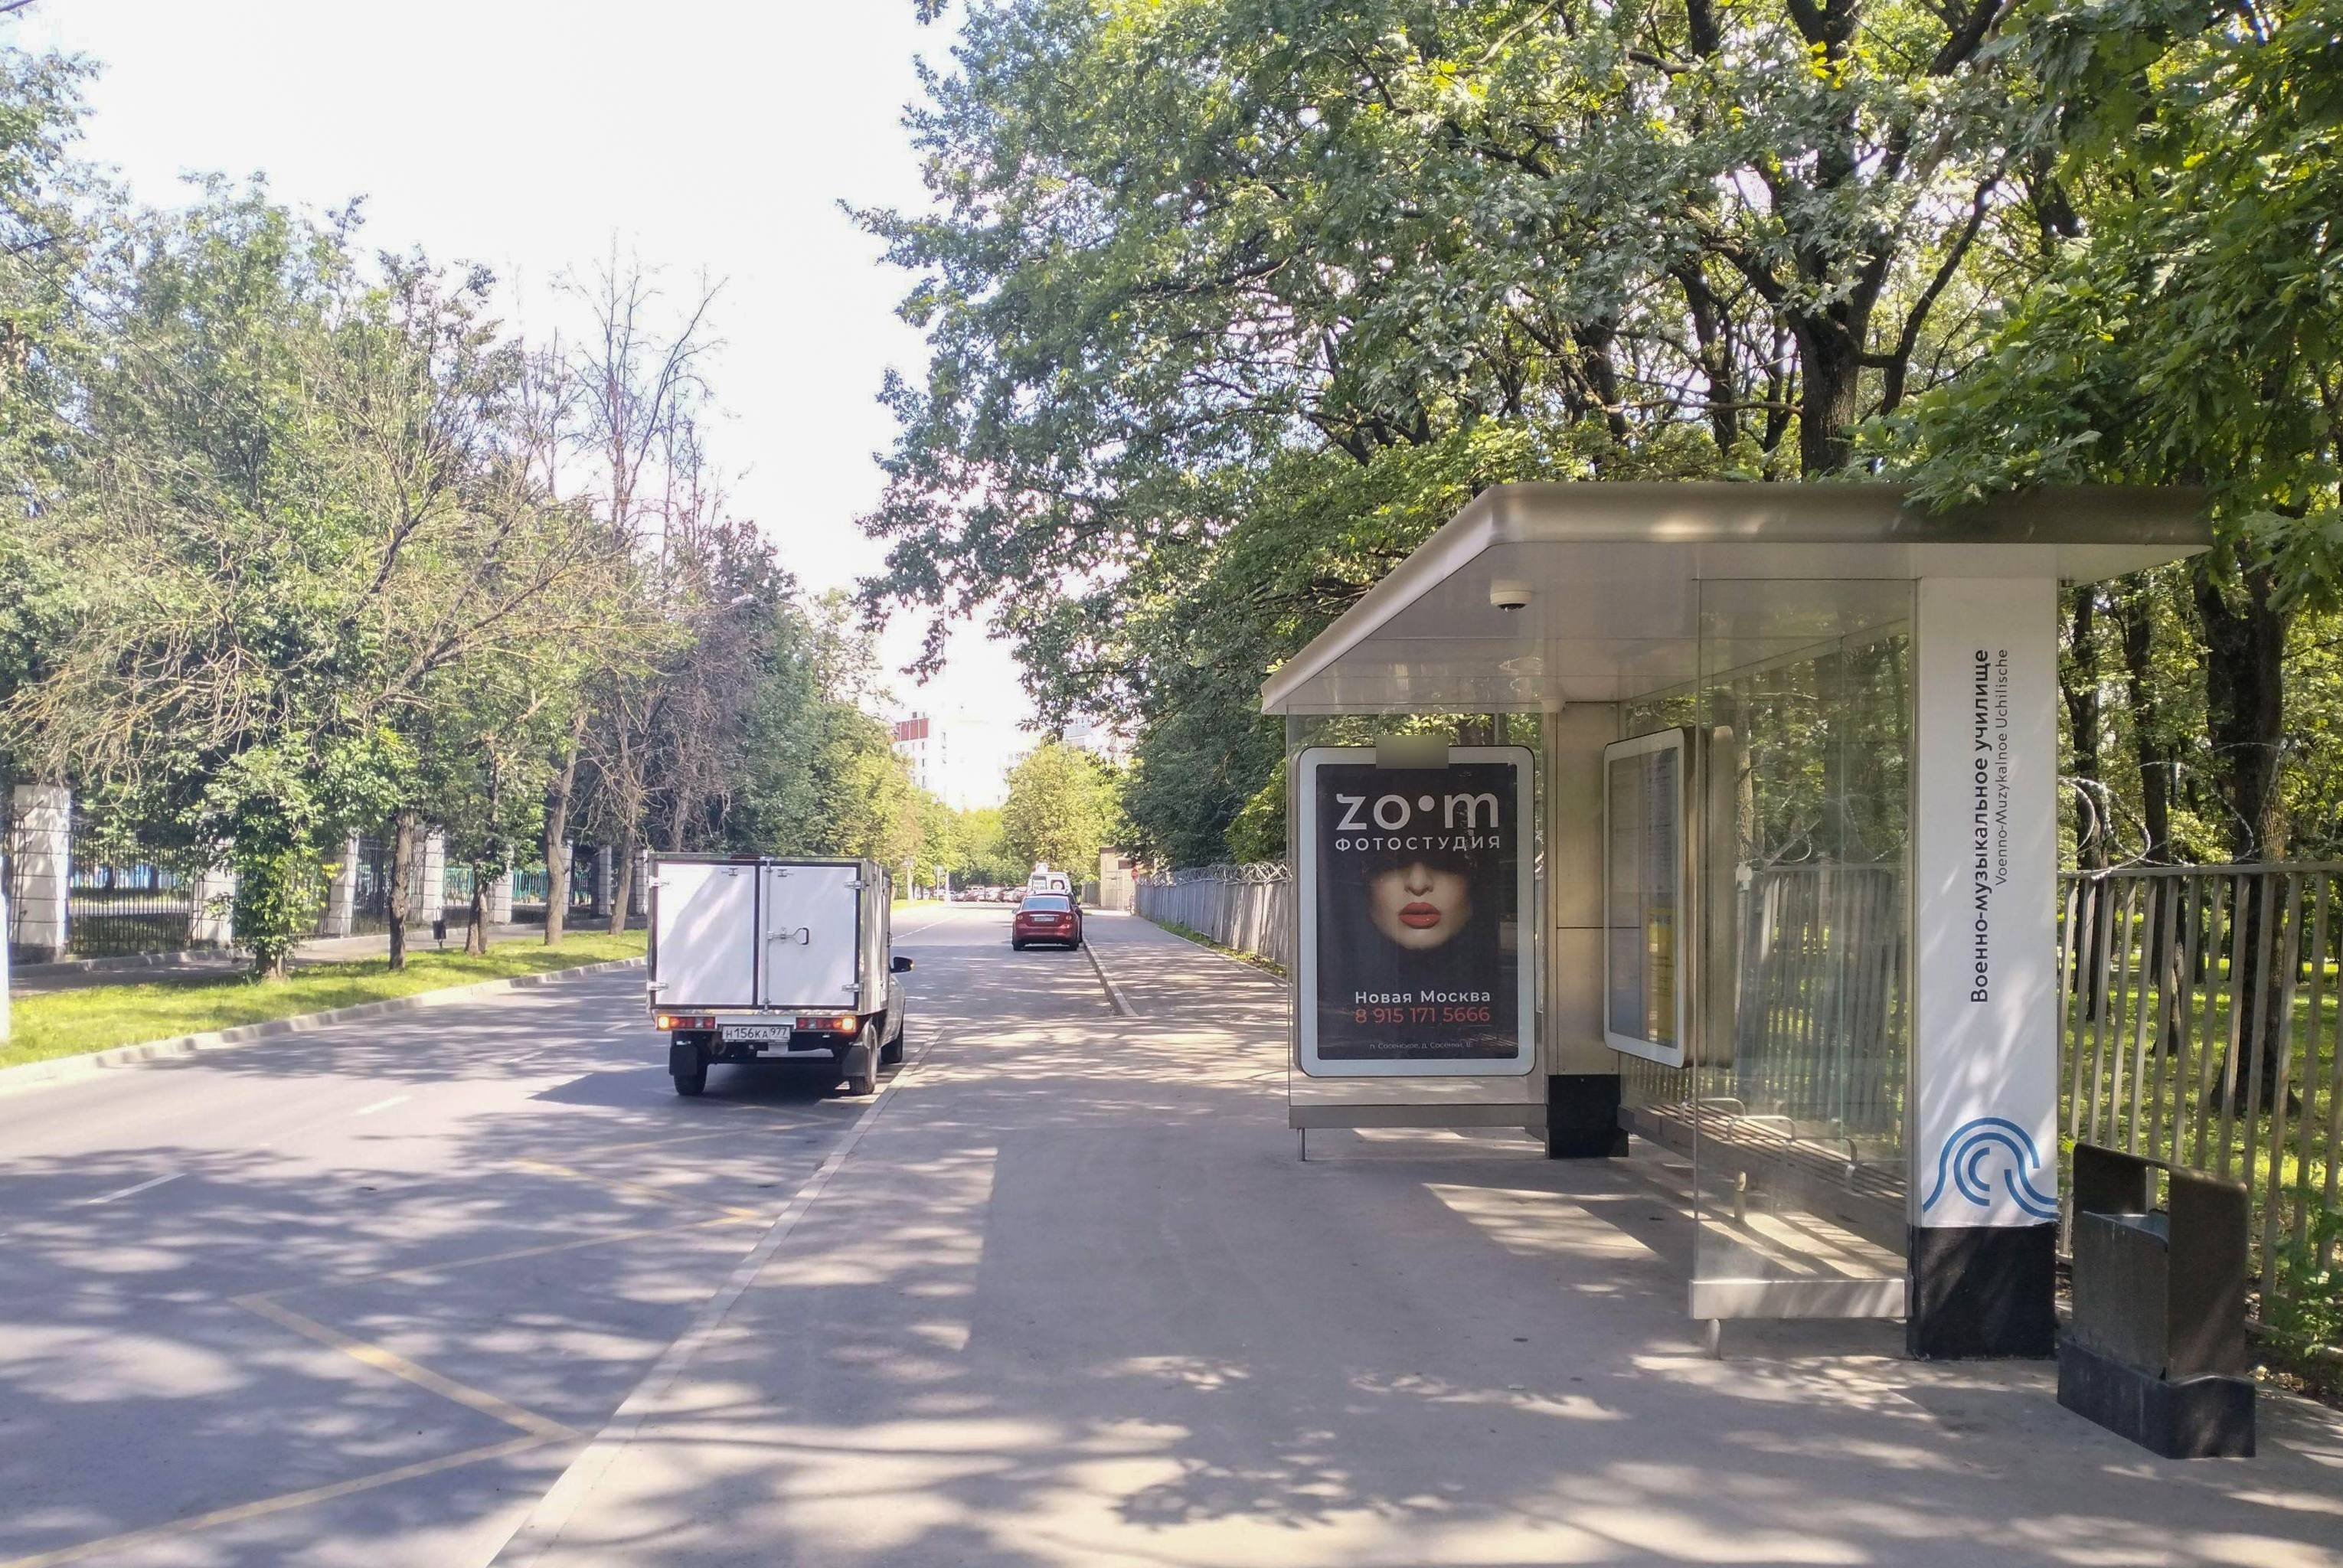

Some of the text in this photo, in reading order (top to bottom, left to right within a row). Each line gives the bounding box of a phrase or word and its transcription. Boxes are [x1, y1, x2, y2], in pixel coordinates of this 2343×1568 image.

[1995, 649, 2010, 886] Voenno-Muzykalnoe Uchilische
[1971, 649, 1992, 1002] Военно-музыкальное училище
[1335, 835, 1500, 852] ФОТОСТУДИЯ
[1355, 990, 1491, 1004] Новая Москва
[1354, 1006, 1491, 1024] 8 915 171 5666
